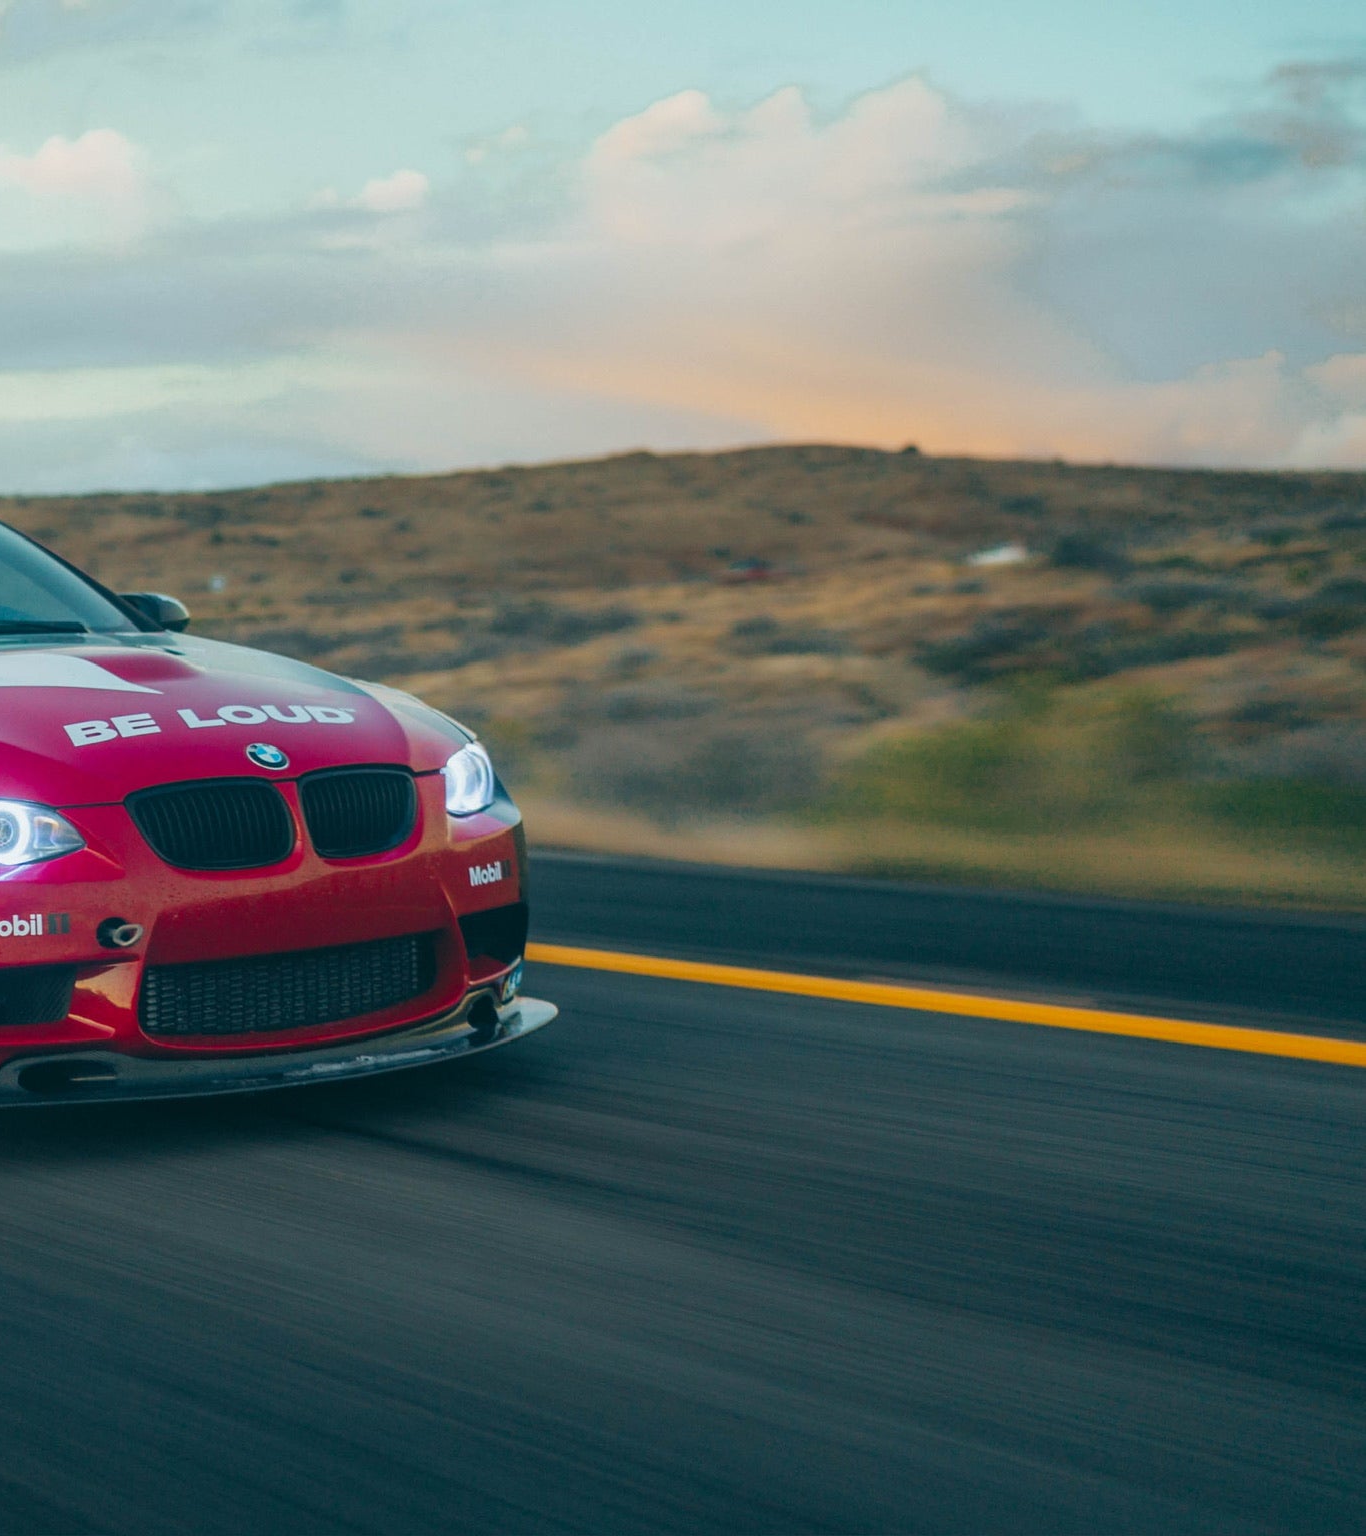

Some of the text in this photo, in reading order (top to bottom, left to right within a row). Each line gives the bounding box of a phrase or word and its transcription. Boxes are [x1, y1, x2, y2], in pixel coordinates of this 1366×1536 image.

[63, 705, 355, 747] BE LOUD
[468, 861, 502, 886] Mobil
